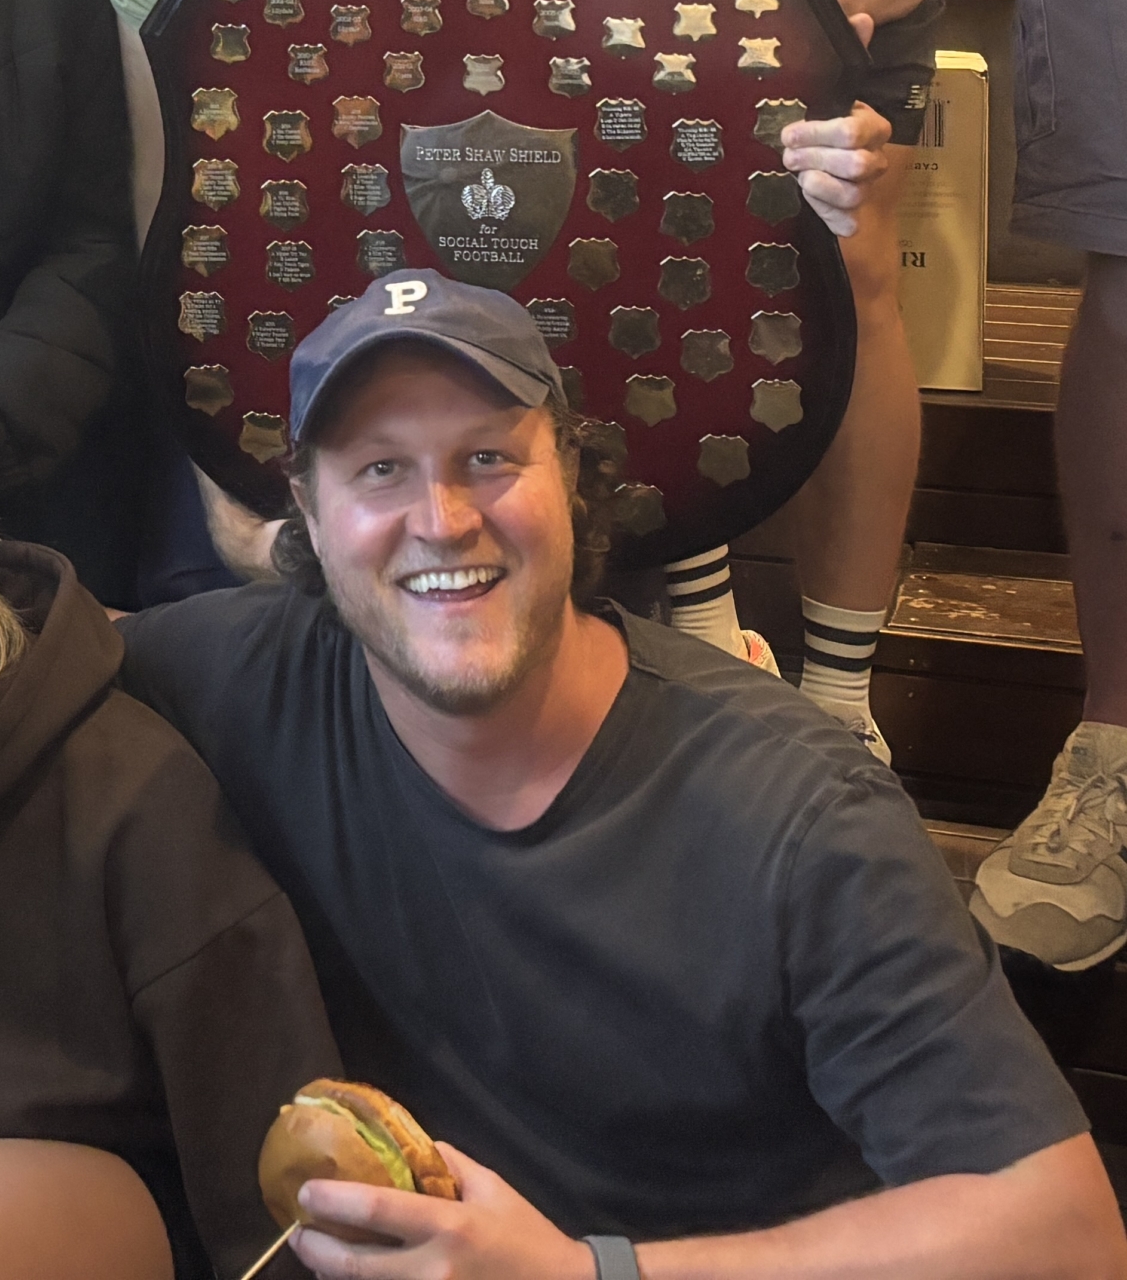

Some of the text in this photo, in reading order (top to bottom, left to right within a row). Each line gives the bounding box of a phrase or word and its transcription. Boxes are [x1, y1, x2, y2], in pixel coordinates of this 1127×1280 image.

[415, 146, 562, 164] PETER SHAW SHIELD
[479, 224, 499, 235] for
[438, 236, 540, 250] SOCIAL TOUCH
[453, 250, 525, 263] FOOTBALL
[384, 280, 428, 315] P
